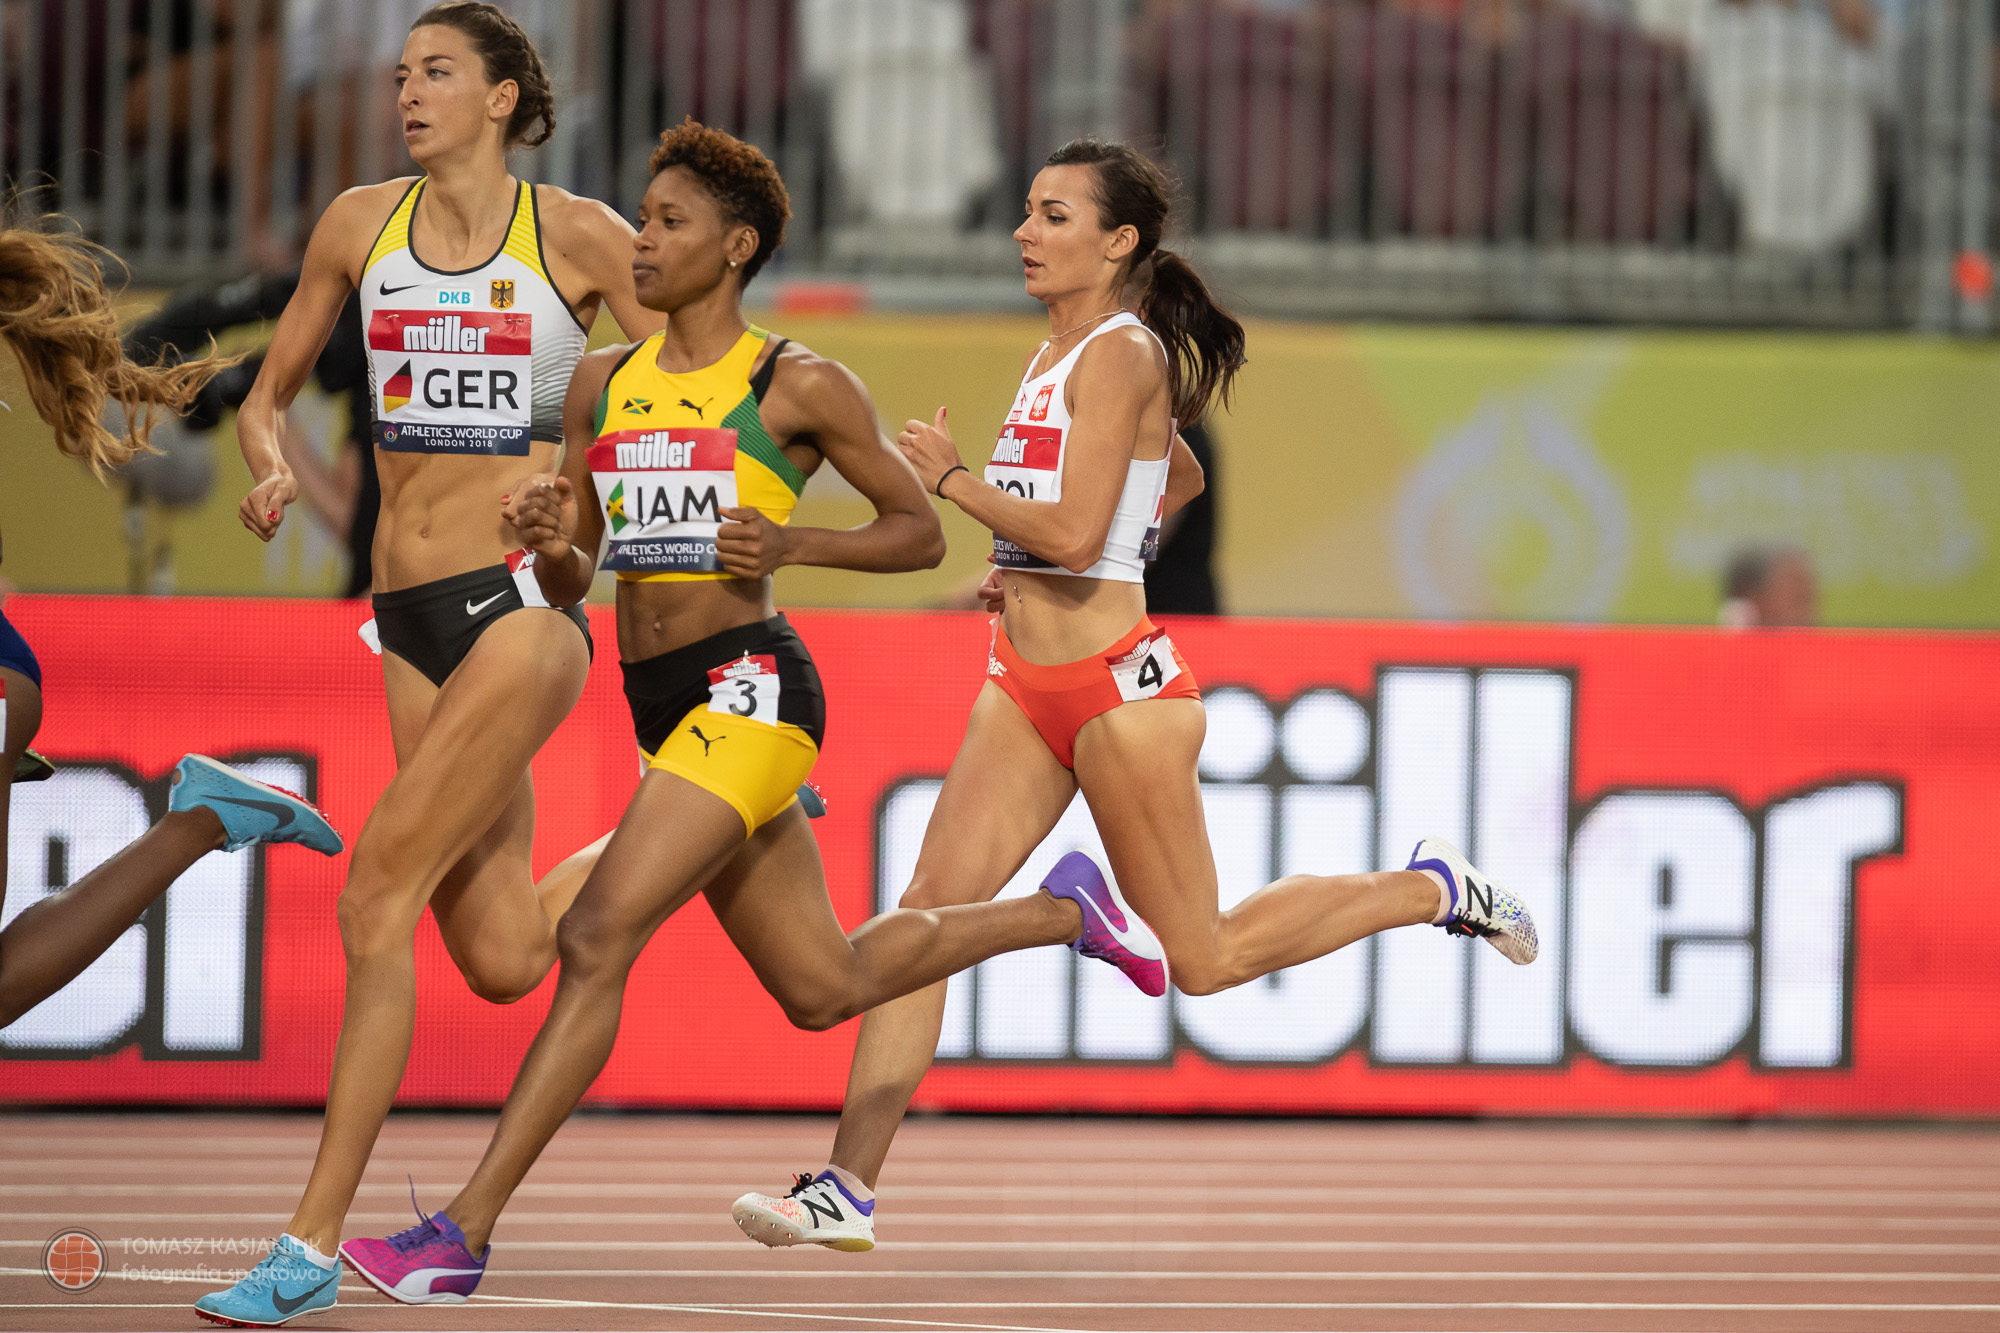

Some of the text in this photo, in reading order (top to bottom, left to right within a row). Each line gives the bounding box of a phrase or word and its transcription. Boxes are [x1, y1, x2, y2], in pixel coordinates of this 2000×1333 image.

[438, 291, 471, 304] DKB
[402, 315, 490, 353] müller
[423, 368, 519, 410] GER
[401, 425, 523, 440] ATHLETICS WORLD CUP
[425, 438, 493, 448] LONDON 2018
[615, 430, 696, 469] müller
[633, 554, 699, 564] LONDON 2018
[664, 542, 704, 554] WORLD
[1137, 653, 1163, 689] 4
[728, 680, 757, 717] 3
